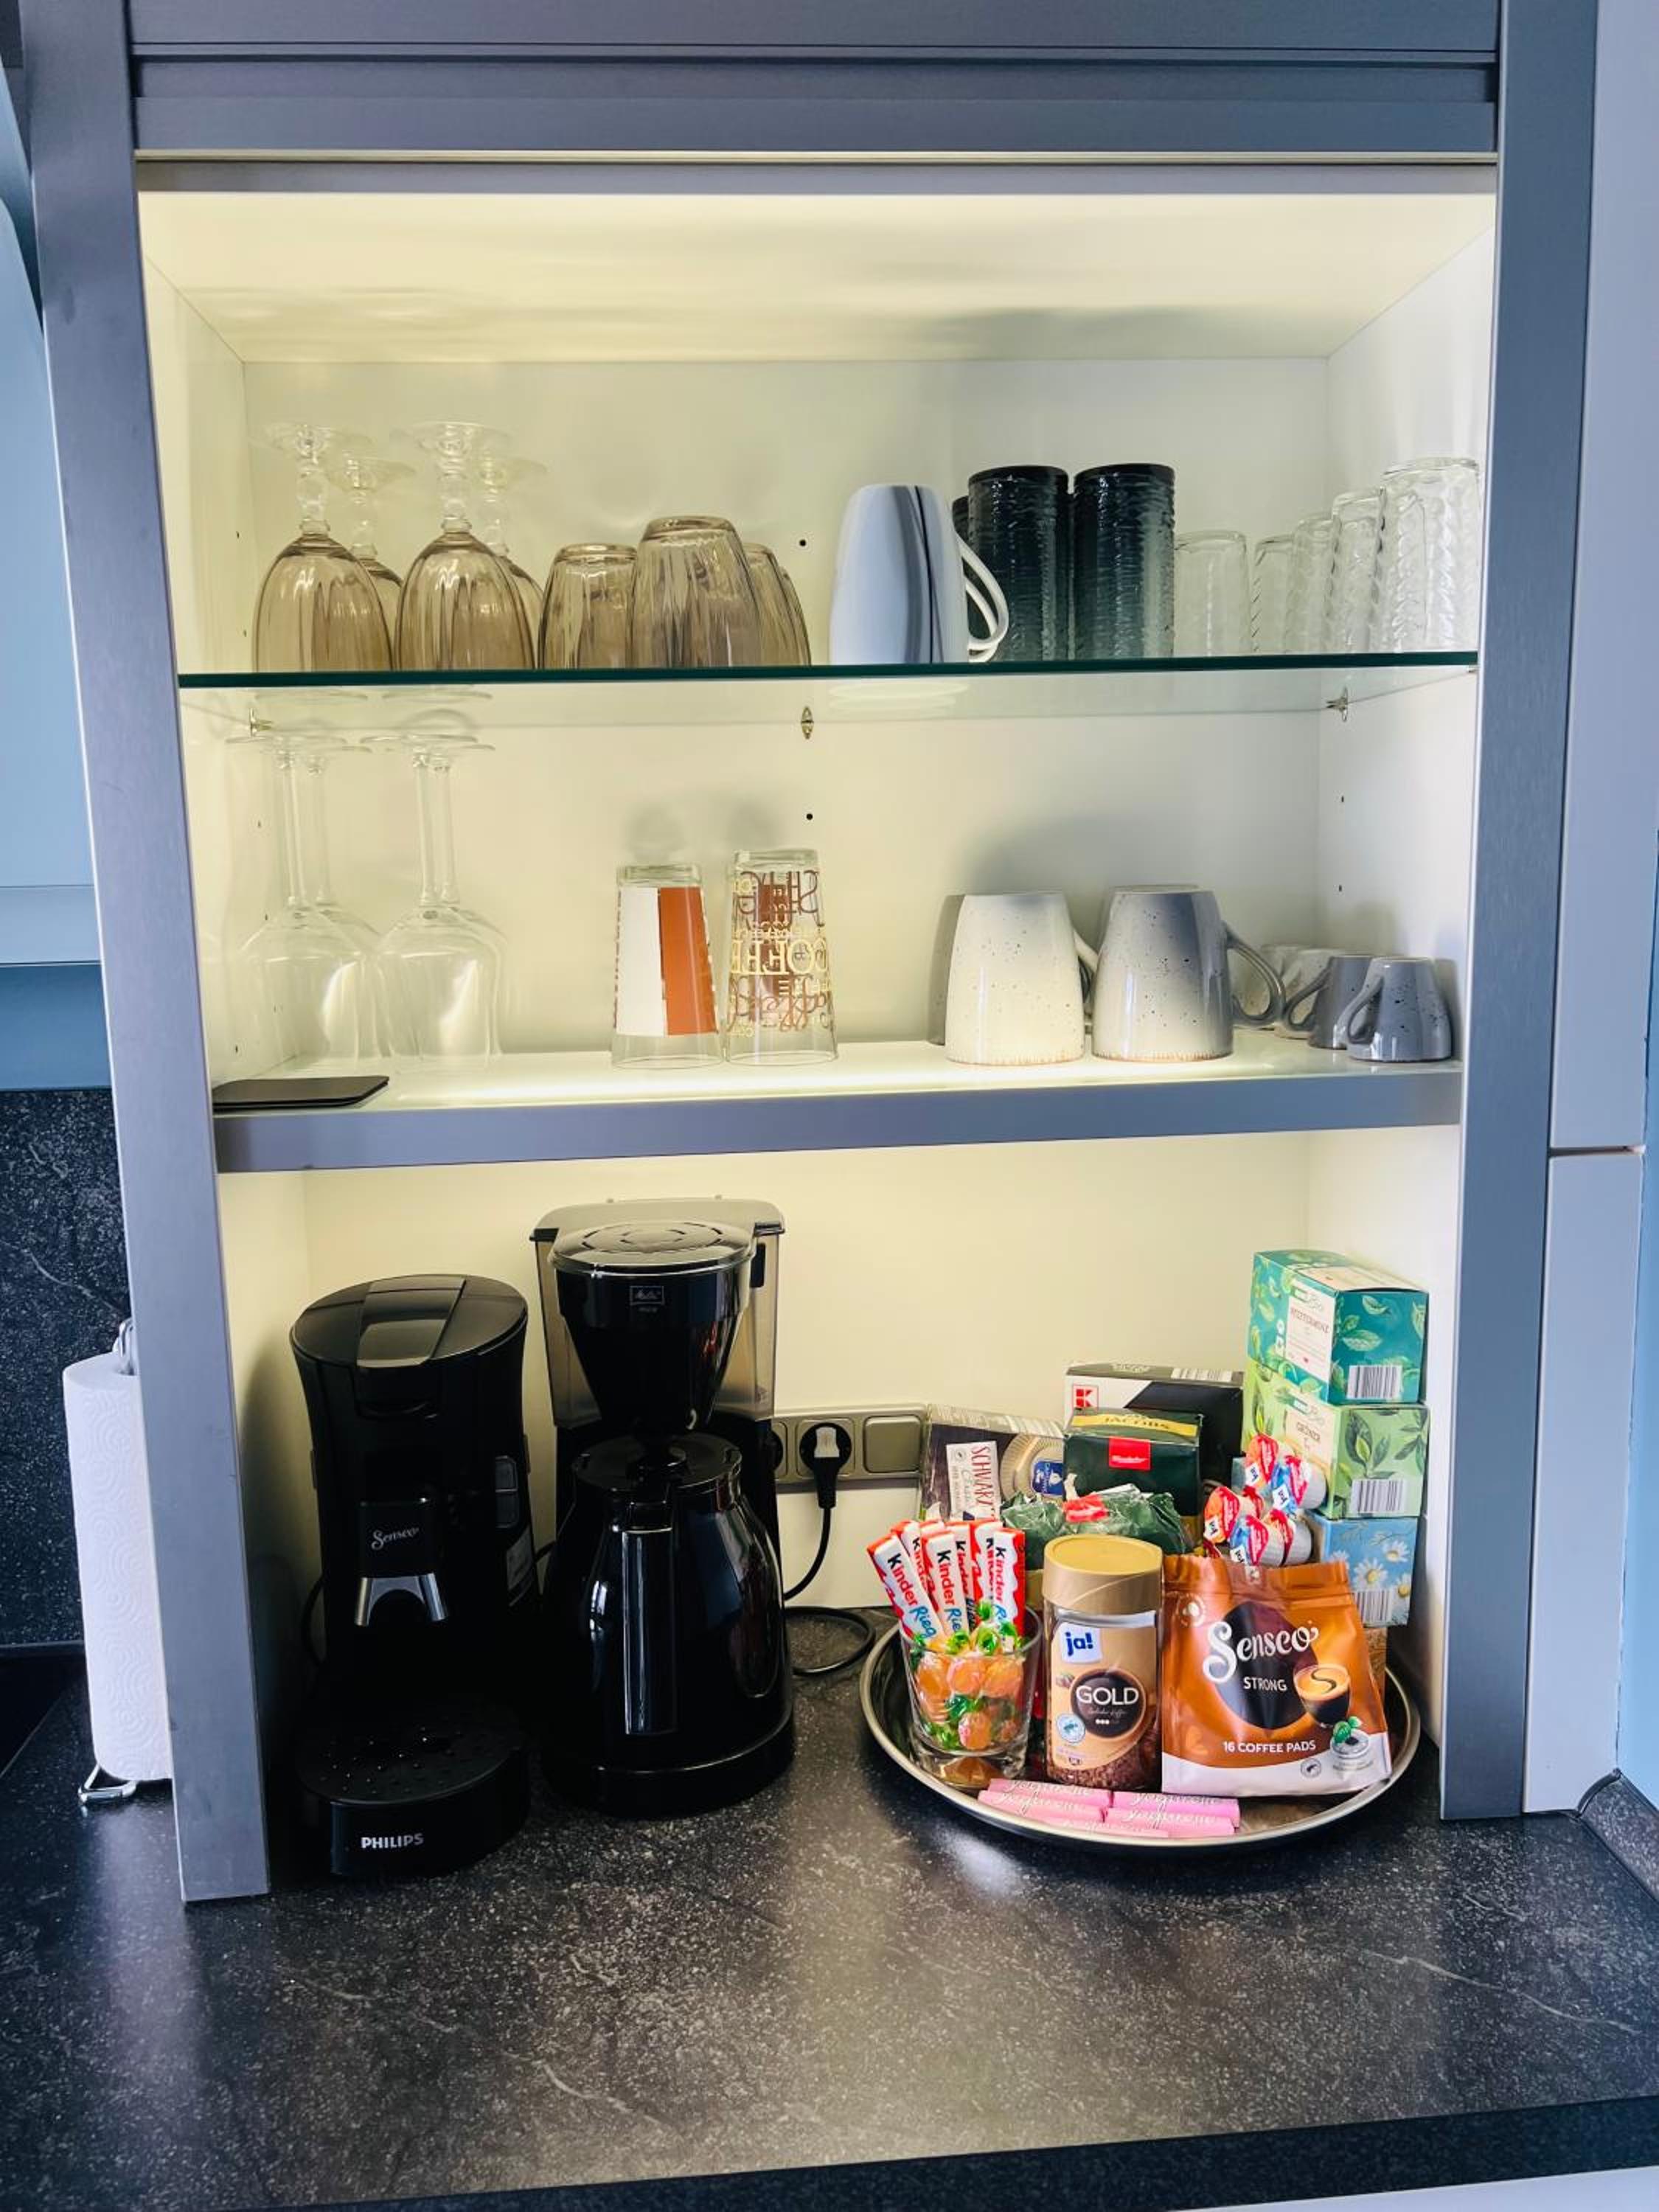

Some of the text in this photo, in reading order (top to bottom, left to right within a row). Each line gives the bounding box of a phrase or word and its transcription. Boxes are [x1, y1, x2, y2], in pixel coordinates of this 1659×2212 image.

[1065, 1631, 1093, 1656] ja!
[1203, 1621, 1319, 1683] Senseo
[1243, 1676, 1288, 1692] STRONG
[1076, 1685, 1139, 1705] GOLD
[1223, 1740, 1316, 1753] 16 COFFEE PADS
[361, 1833, 424, 1848] PHILIPS
